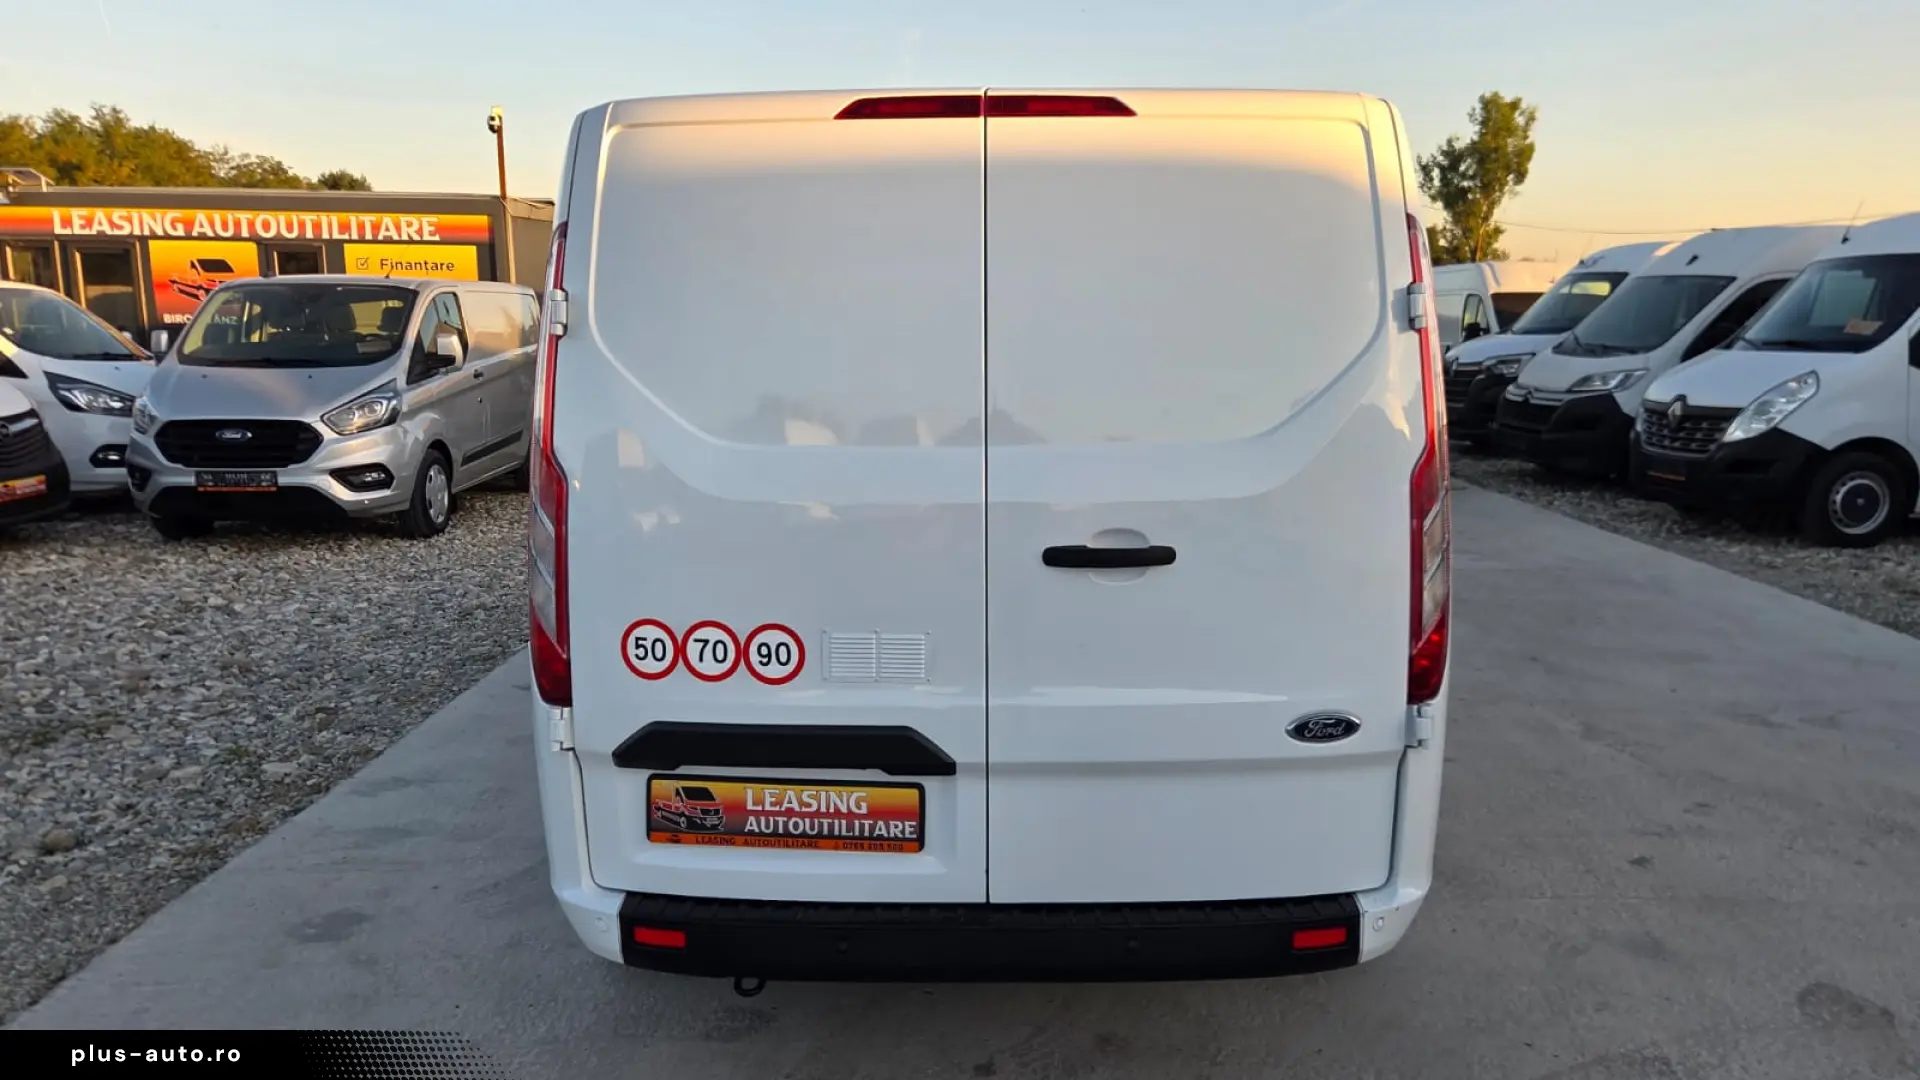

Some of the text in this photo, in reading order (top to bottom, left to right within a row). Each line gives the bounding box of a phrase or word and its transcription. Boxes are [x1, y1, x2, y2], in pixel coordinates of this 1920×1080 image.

[52, 209, 441, 241] LEASING AUTOUTILITARE
[634, 636, 792, 667] 50 70 90
[1303, 719, 1346, 738] Ford
[744, 788, 868, 815] LEASING
[744, 815, 918, 839] AUTOUTILITARE
[695, 835, 736, 846] LEASING
[742, 837, 820, 849] AUTOUTILITARE
